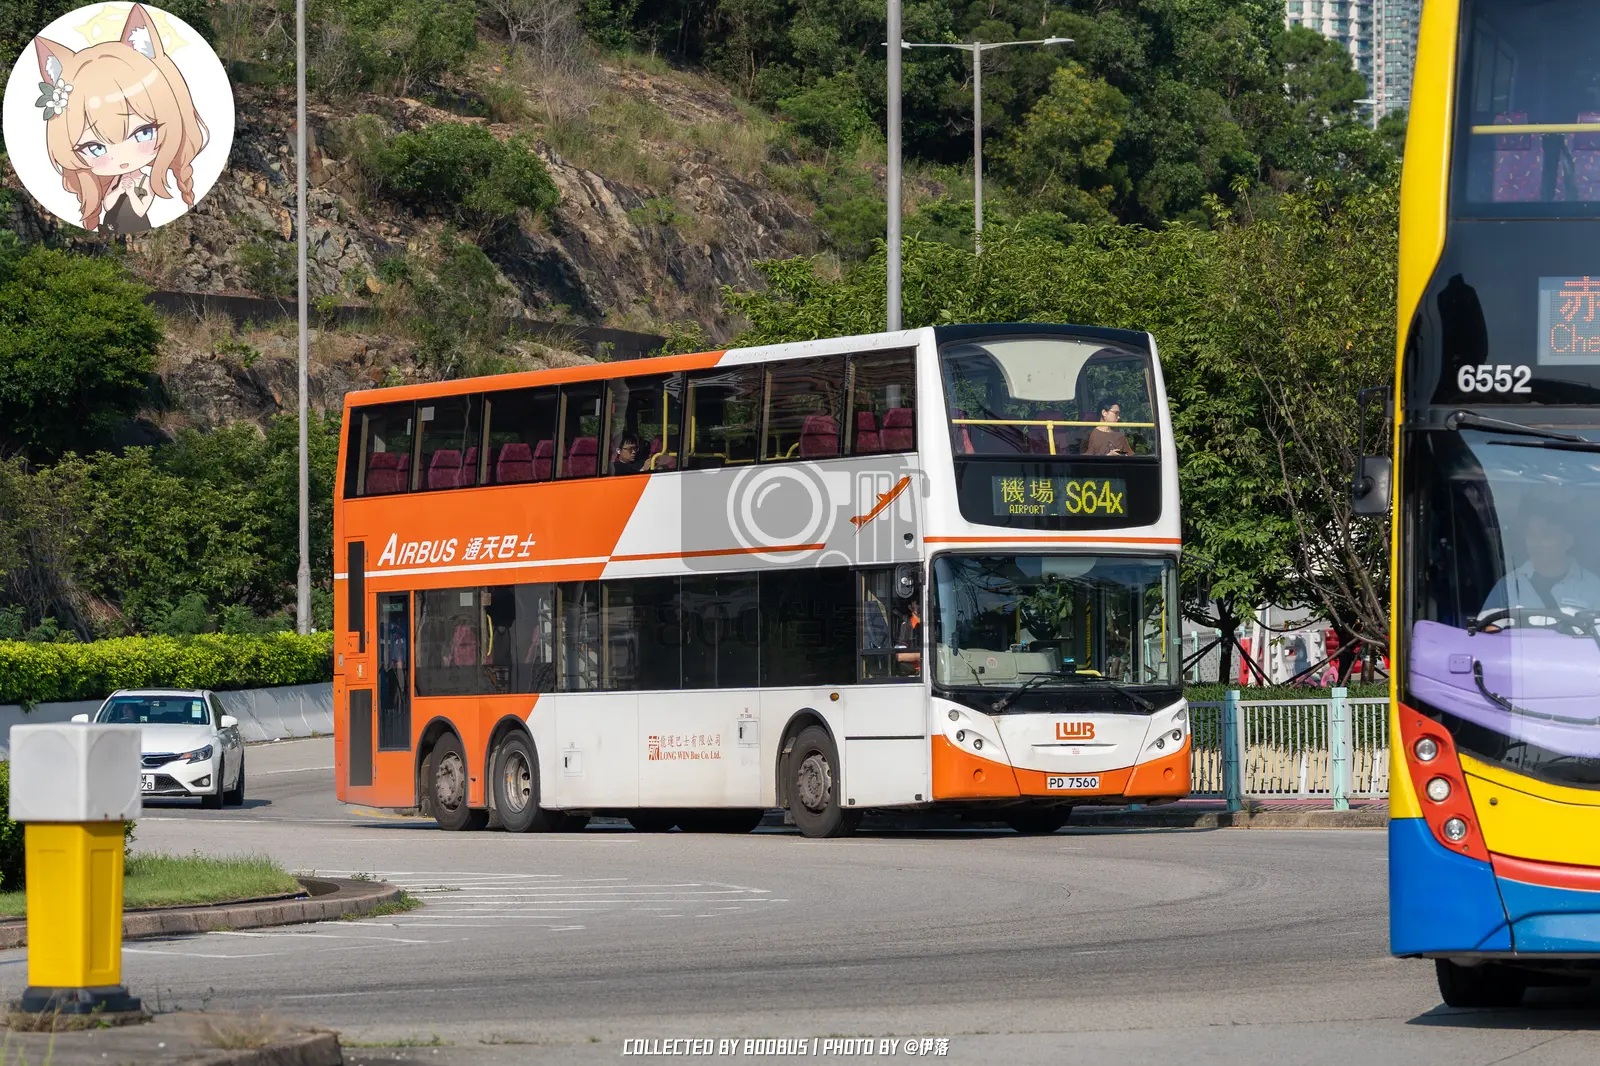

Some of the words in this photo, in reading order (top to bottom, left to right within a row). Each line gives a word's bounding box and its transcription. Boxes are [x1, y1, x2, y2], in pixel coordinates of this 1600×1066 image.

[1457, 365, 1532, 393] 6552
[1001, 478, 1054, 503] 機場
[1065, 481, 1123, 514] S64x
[1009, 505, 1045, 514] AIRPORT
[377, 532, 458, 566] AIRBUS
[461, 533, 536, 561] 通天巴士
[1055, 722, 1096, 741] LWB
[660, 751, 677, 760] LONG
[677, 751, 690, 760] WIN
[690, 751, 700, 760] Bus
[1049, 777, 1064, 788] PD
[1068, 777, 1097, 788] 7560
